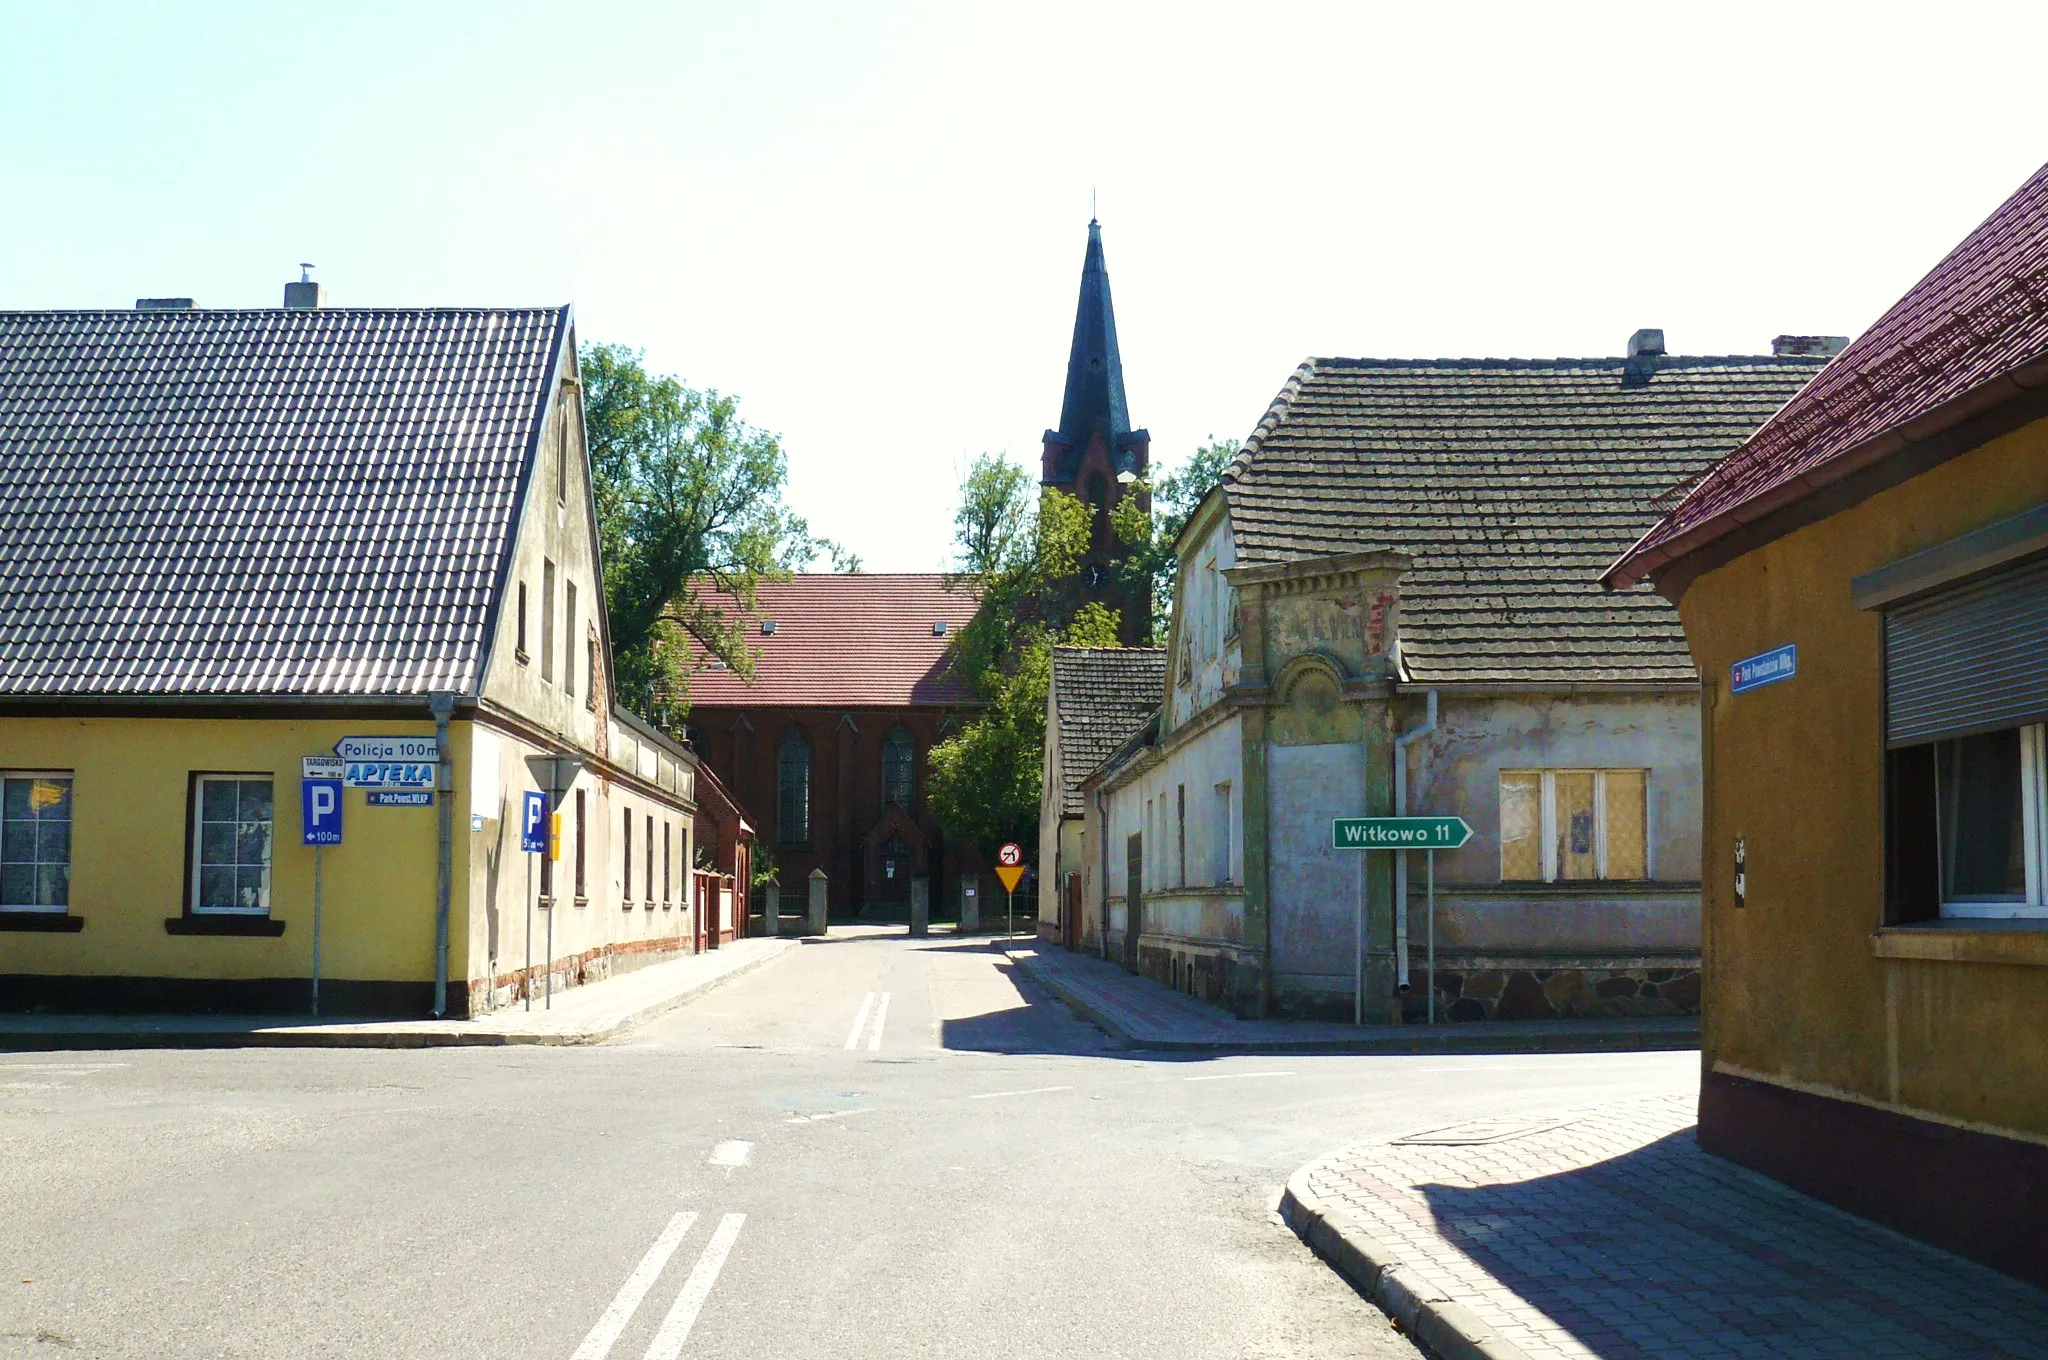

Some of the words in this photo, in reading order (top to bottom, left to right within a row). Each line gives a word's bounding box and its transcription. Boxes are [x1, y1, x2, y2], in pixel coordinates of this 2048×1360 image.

[345, 743, 393, 758] Policja
[399, 743, 438, 756] 100m
[306, 758, 343, 767] TARGOWISKO
[346, 764, 432, 781] APTEKA
[312, 786, 335, 826] P
[527, 796, 542, 834] P
[316, 831, 340, 842] 100m
[1344, 825, 1428, 841] Witkowo
[1435, 824, 1450, 841] 11
